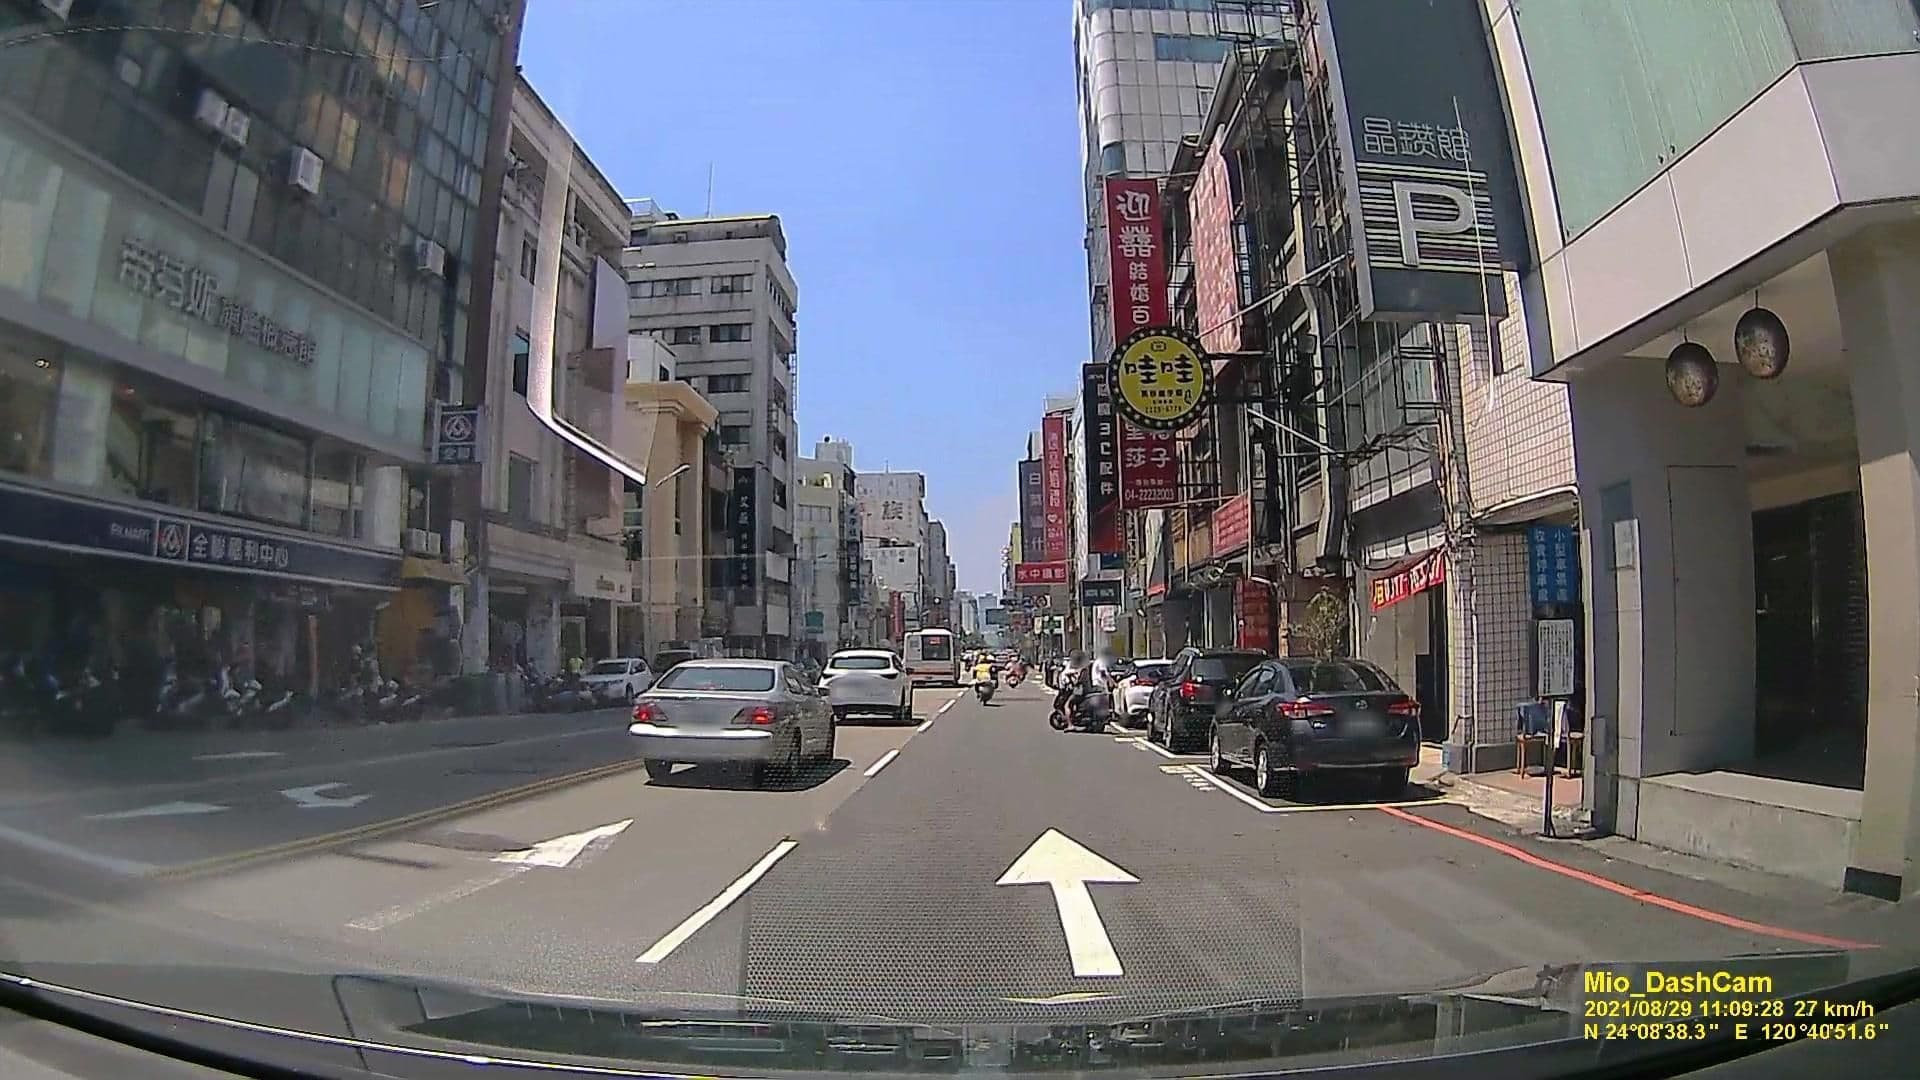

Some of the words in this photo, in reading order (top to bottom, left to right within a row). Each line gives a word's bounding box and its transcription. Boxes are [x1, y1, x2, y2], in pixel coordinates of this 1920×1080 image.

[1363, 116, 1473, 162] 晶鑽館
[1392, 180, 1475, 266] P
[1124, 354, 1194, 384] 哇哇
